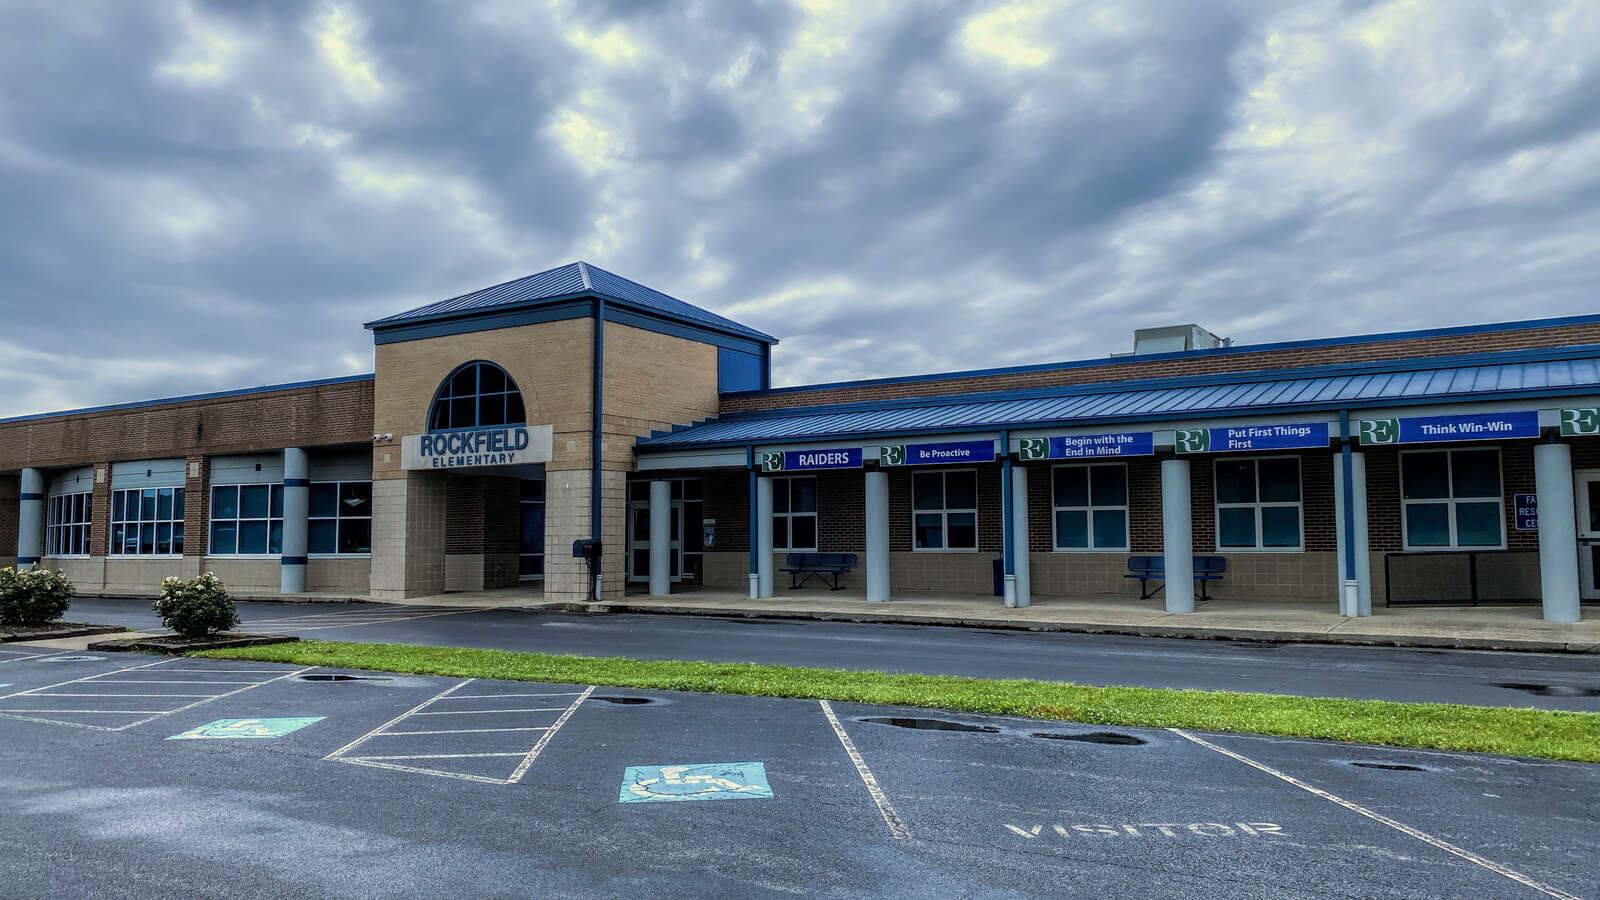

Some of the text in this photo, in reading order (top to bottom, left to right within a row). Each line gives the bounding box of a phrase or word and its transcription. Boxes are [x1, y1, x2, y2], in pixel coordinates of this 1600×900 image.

[1228, 426, 1312, 438] Put First Things
[1421, 421, 1512, 435] Think Win-Win
[420, 428, 529, 457] ROCKFIELD
[1065, 434, 1133, 447] Begin with the
[1228, 439, 1252, 449] First
[919, 448, 970, 458] Be Proactive
[1065, 446, 1121, 456] End in Mind
[432, 452, 515, 468] ELEMENTARY
[799, 452, 849, 466] RAIDERS
[1002, 822, 1290, 838] VISITOR
